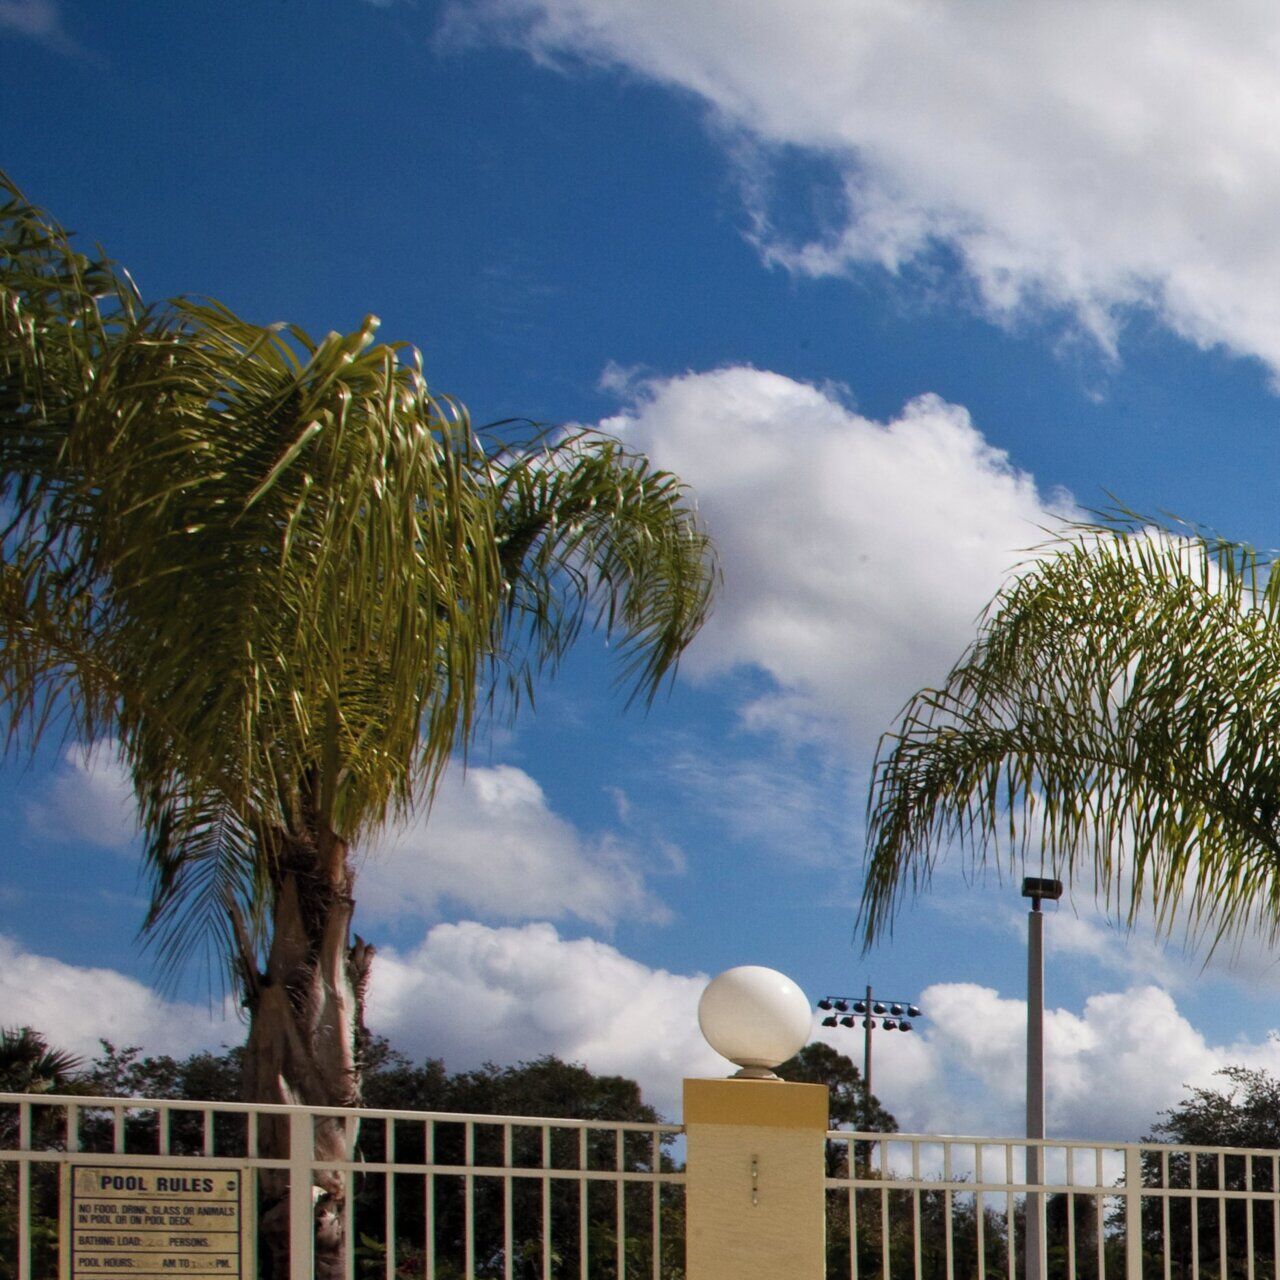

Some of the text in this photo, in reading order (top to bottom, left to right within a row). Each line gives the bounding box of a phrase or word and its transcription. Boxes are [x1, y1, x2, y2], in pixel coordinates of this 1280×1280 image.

[101, 1176, 214, 1192] POOL RULES
[79, 1204, 91, 1213] NO
[152, 1206, 180, 1215] GLASS
[183, 1207, 194, 1215] OR
[197, 1207, 235, 1216] ANIMALS
[79, 1215, 88, 1223] IN
[91, 1215, 112, 1224] POOL
[115, 1215, 127, 1224] OR
[130, 1216, 142, 1224] ON
[145, 1216, 167, 1225] POOL
[79, 1236, 115, 1245] BATHING
[79, 1258, 100, 1267] POOL
[162, 1259, 176, 1268] AM
[179, 1259, 190, 1268] TO
